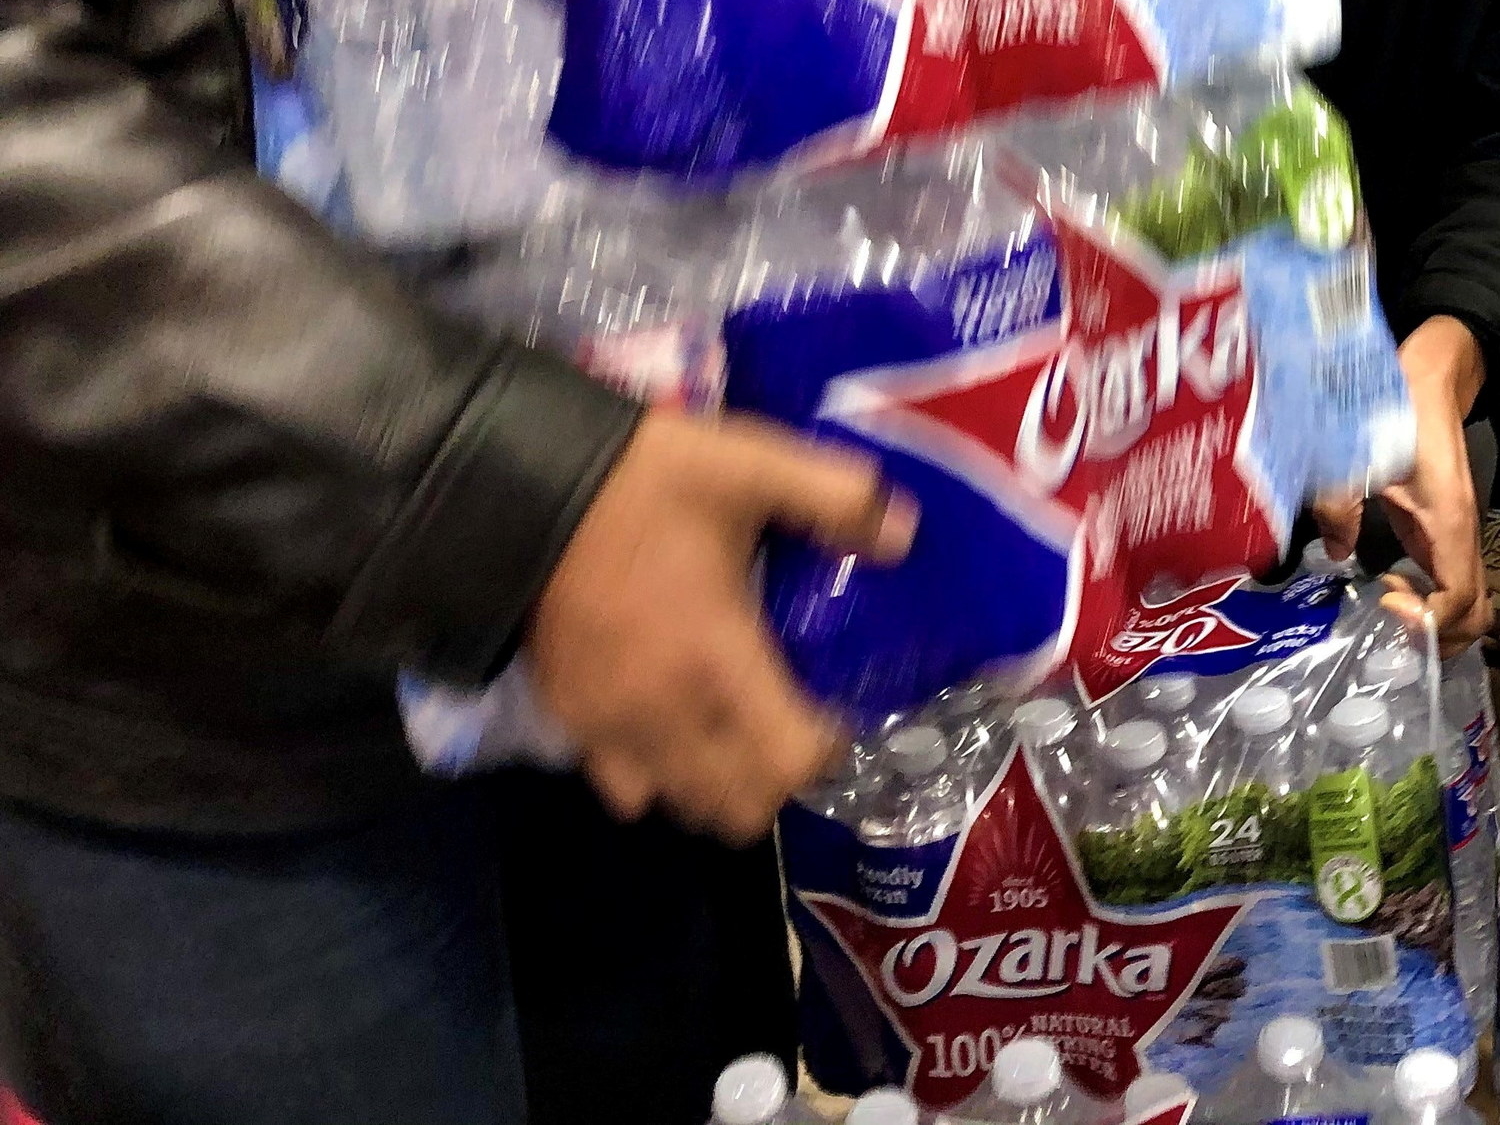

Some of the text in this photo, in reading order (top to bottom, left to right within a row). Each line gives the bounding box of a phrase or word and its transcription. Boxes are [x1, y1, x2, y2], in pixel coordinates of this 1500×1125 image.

[1208, 815, 1264, 848] 24
[878, 922, 1174, 1008] Ozarka
[1030, 1013, 1136, 1038] NATURAL
